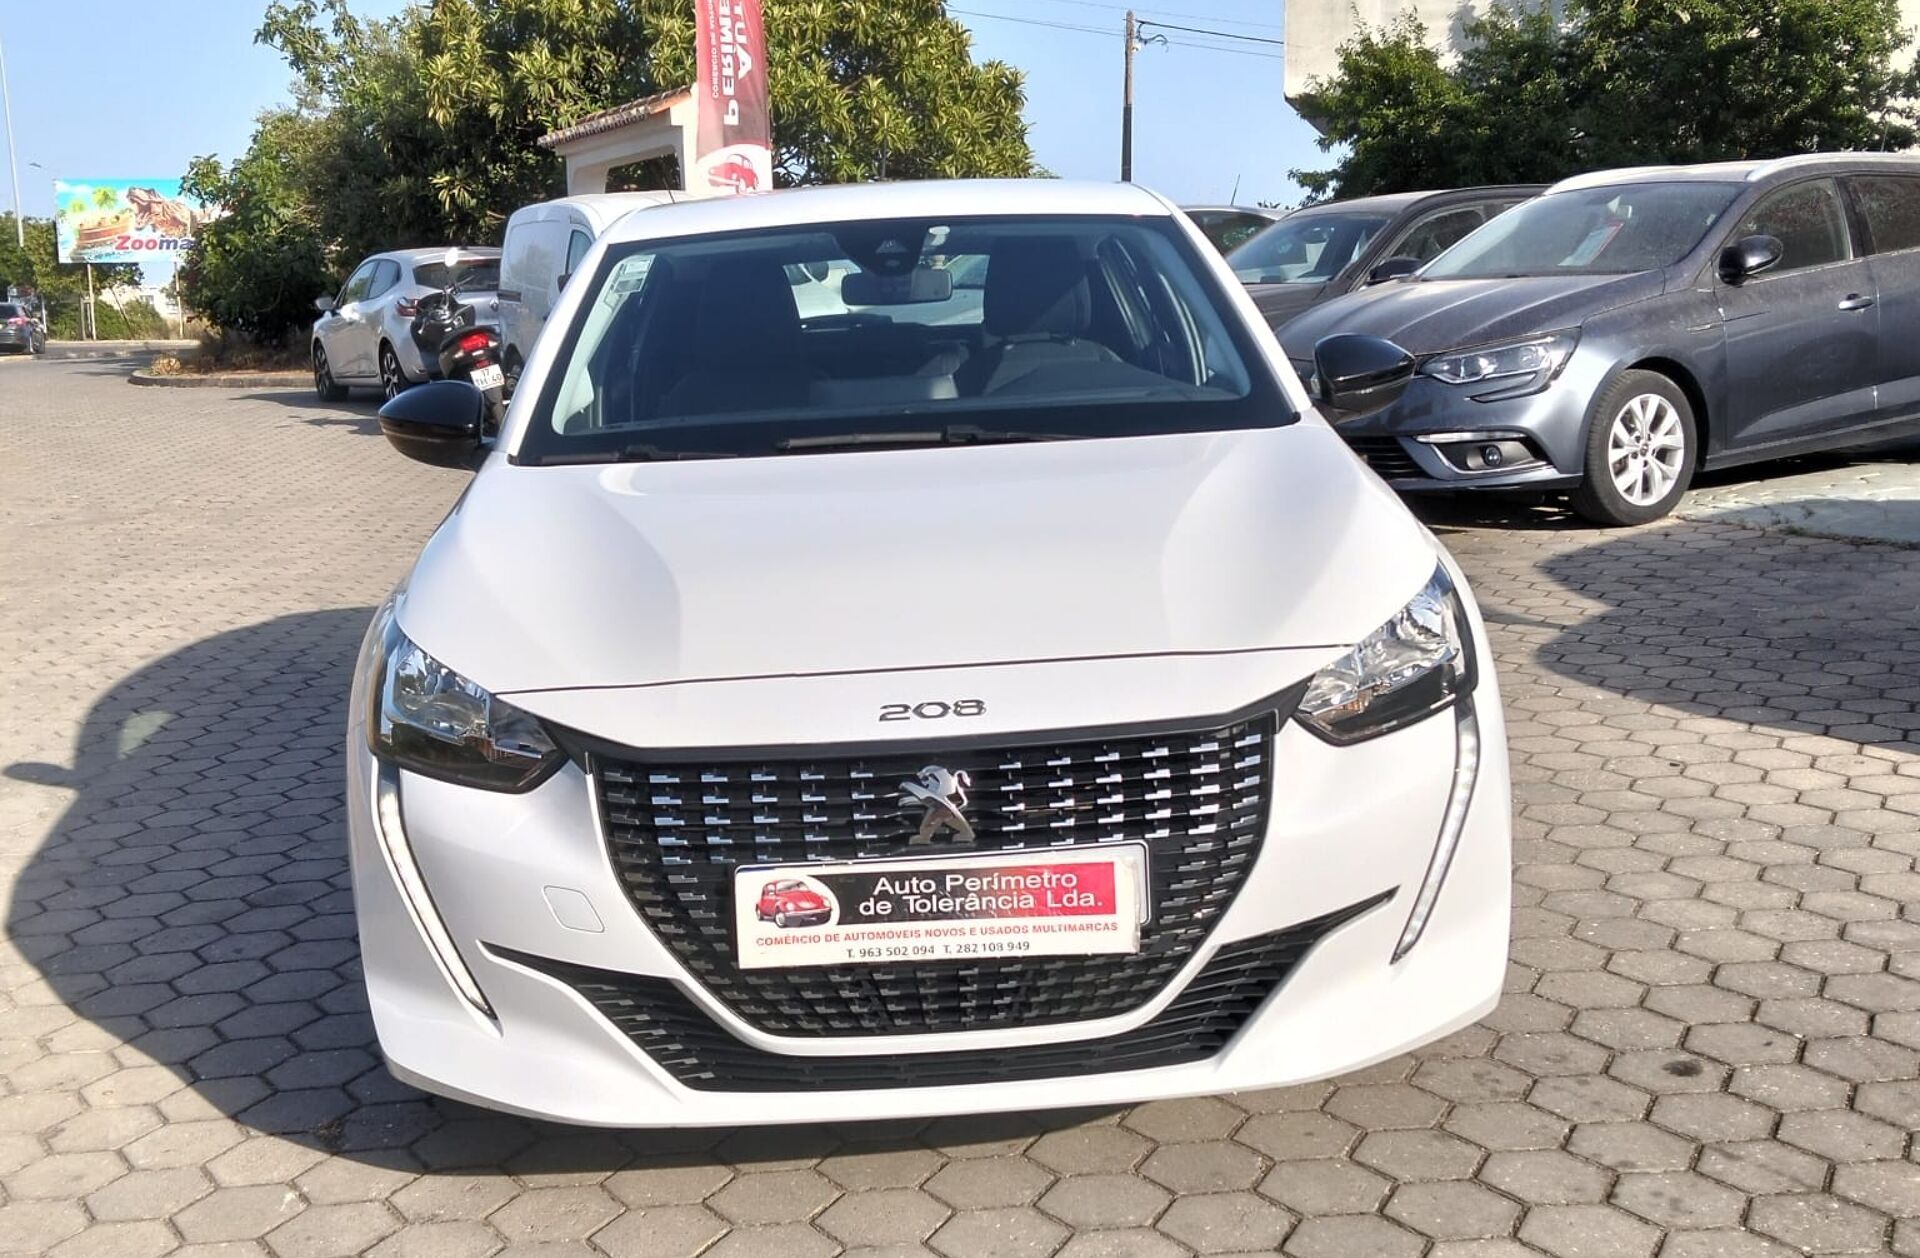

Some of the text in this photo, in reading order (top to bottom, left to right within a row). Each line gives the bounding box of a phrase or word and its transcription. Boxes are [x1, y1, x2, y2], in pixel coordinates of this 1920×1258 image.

[879, 699, 986, 721] 208
[873, 870, 1078, 895] Auto Perímetro
[859, 889, 1103, 915] de Tolerância Lda.
[756, 934, 821, 946] COMÉRCIO
[825, 933, 840, 943] DE
[925, 927, 967, 938] NOVOS
[970, 927, 977, 936] E
[980, 924, 1029, 936] USADOS
[1032, 922, 1118, 934] MULTIMARCAS
[859, 947, 882, 958] 963
[886, 946, 909, 956] 502
[913, 944, 935, 955] 094
[944, 944, 952, 954] T.
[956, 943, 978, 954] 282
[1007, 941, 1030, 951] 949
